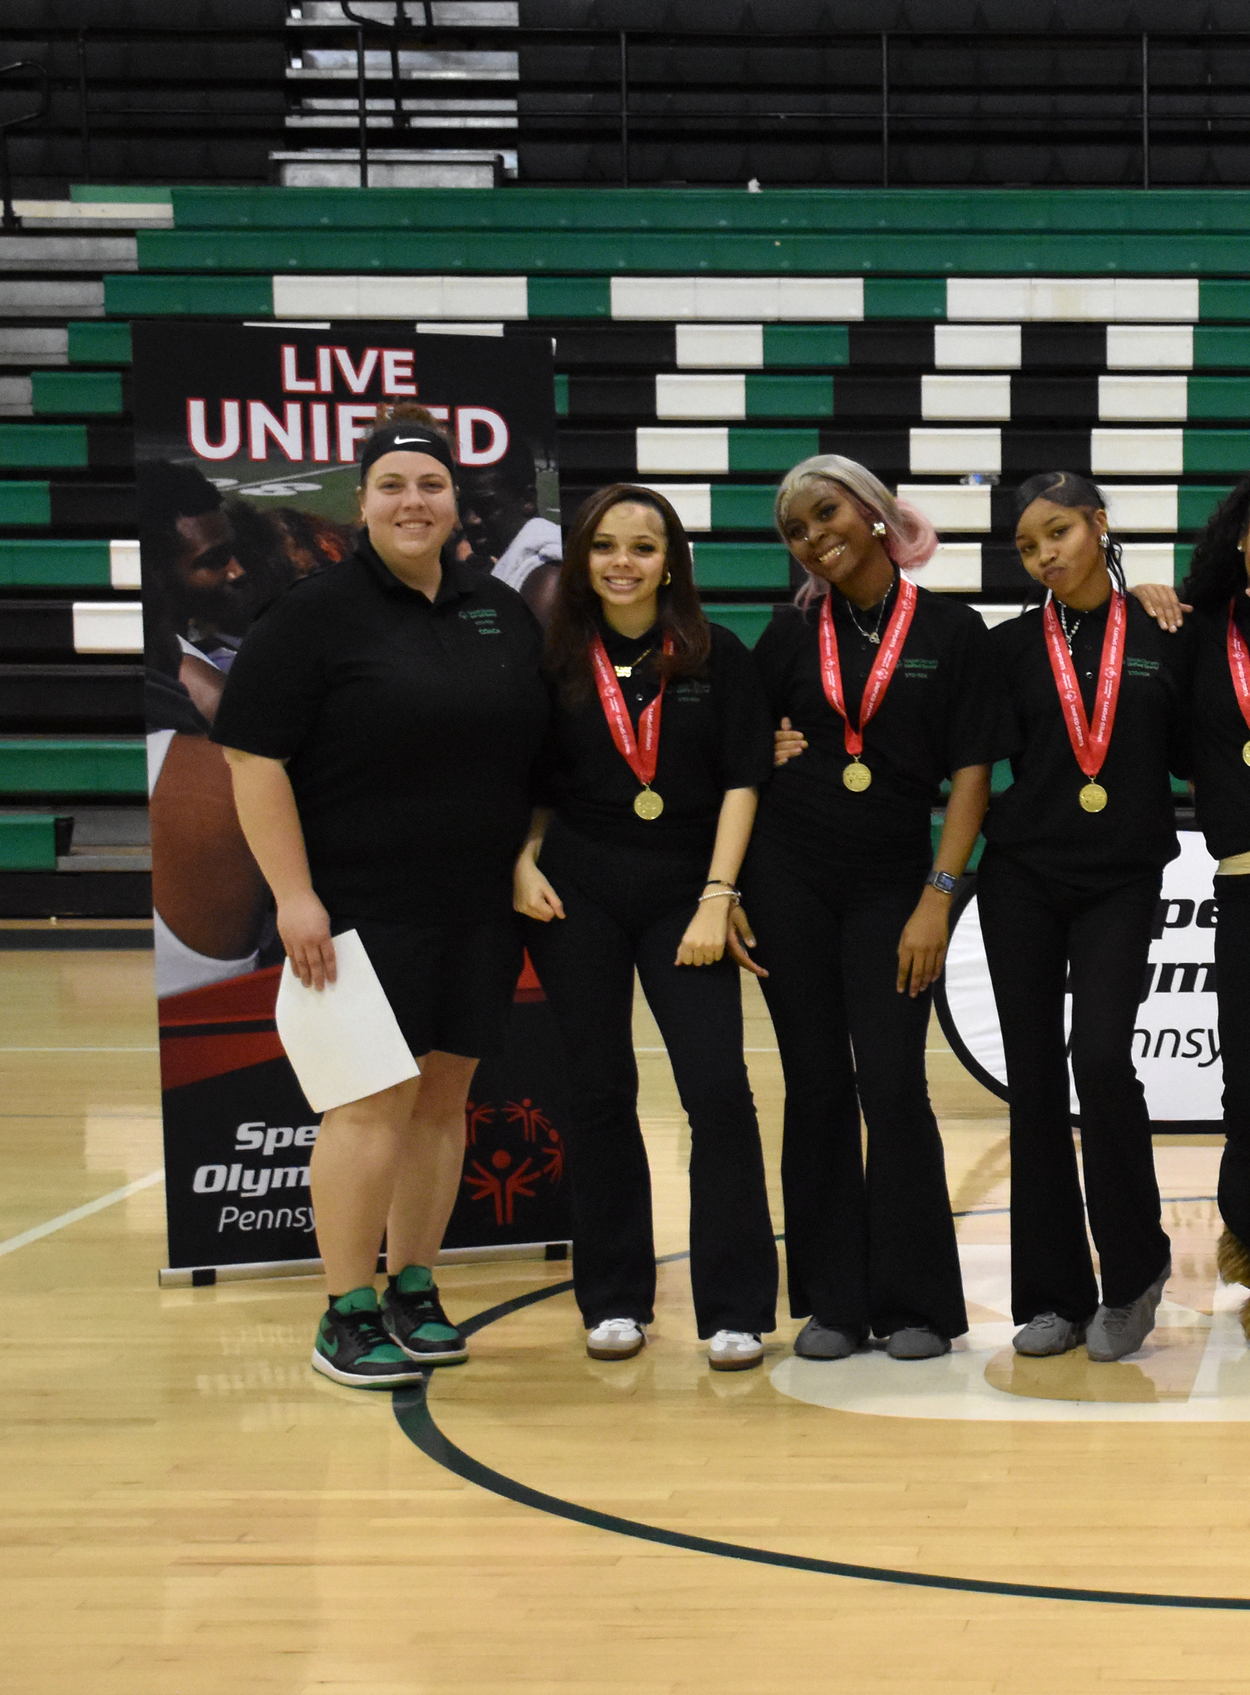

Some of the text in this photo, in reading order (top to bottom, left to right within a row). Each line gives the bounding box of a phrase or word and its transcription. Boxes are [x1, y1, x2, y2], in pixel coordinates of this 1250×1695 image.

[280, 344, 418, 396] LIVE
[186, 397, 510, 467] UNIFD
[234, 1121, 320, 1156] Spe
[192, 1163, 311, 1199] Olym
[218, 1204, 316, 1233] Pennsy
